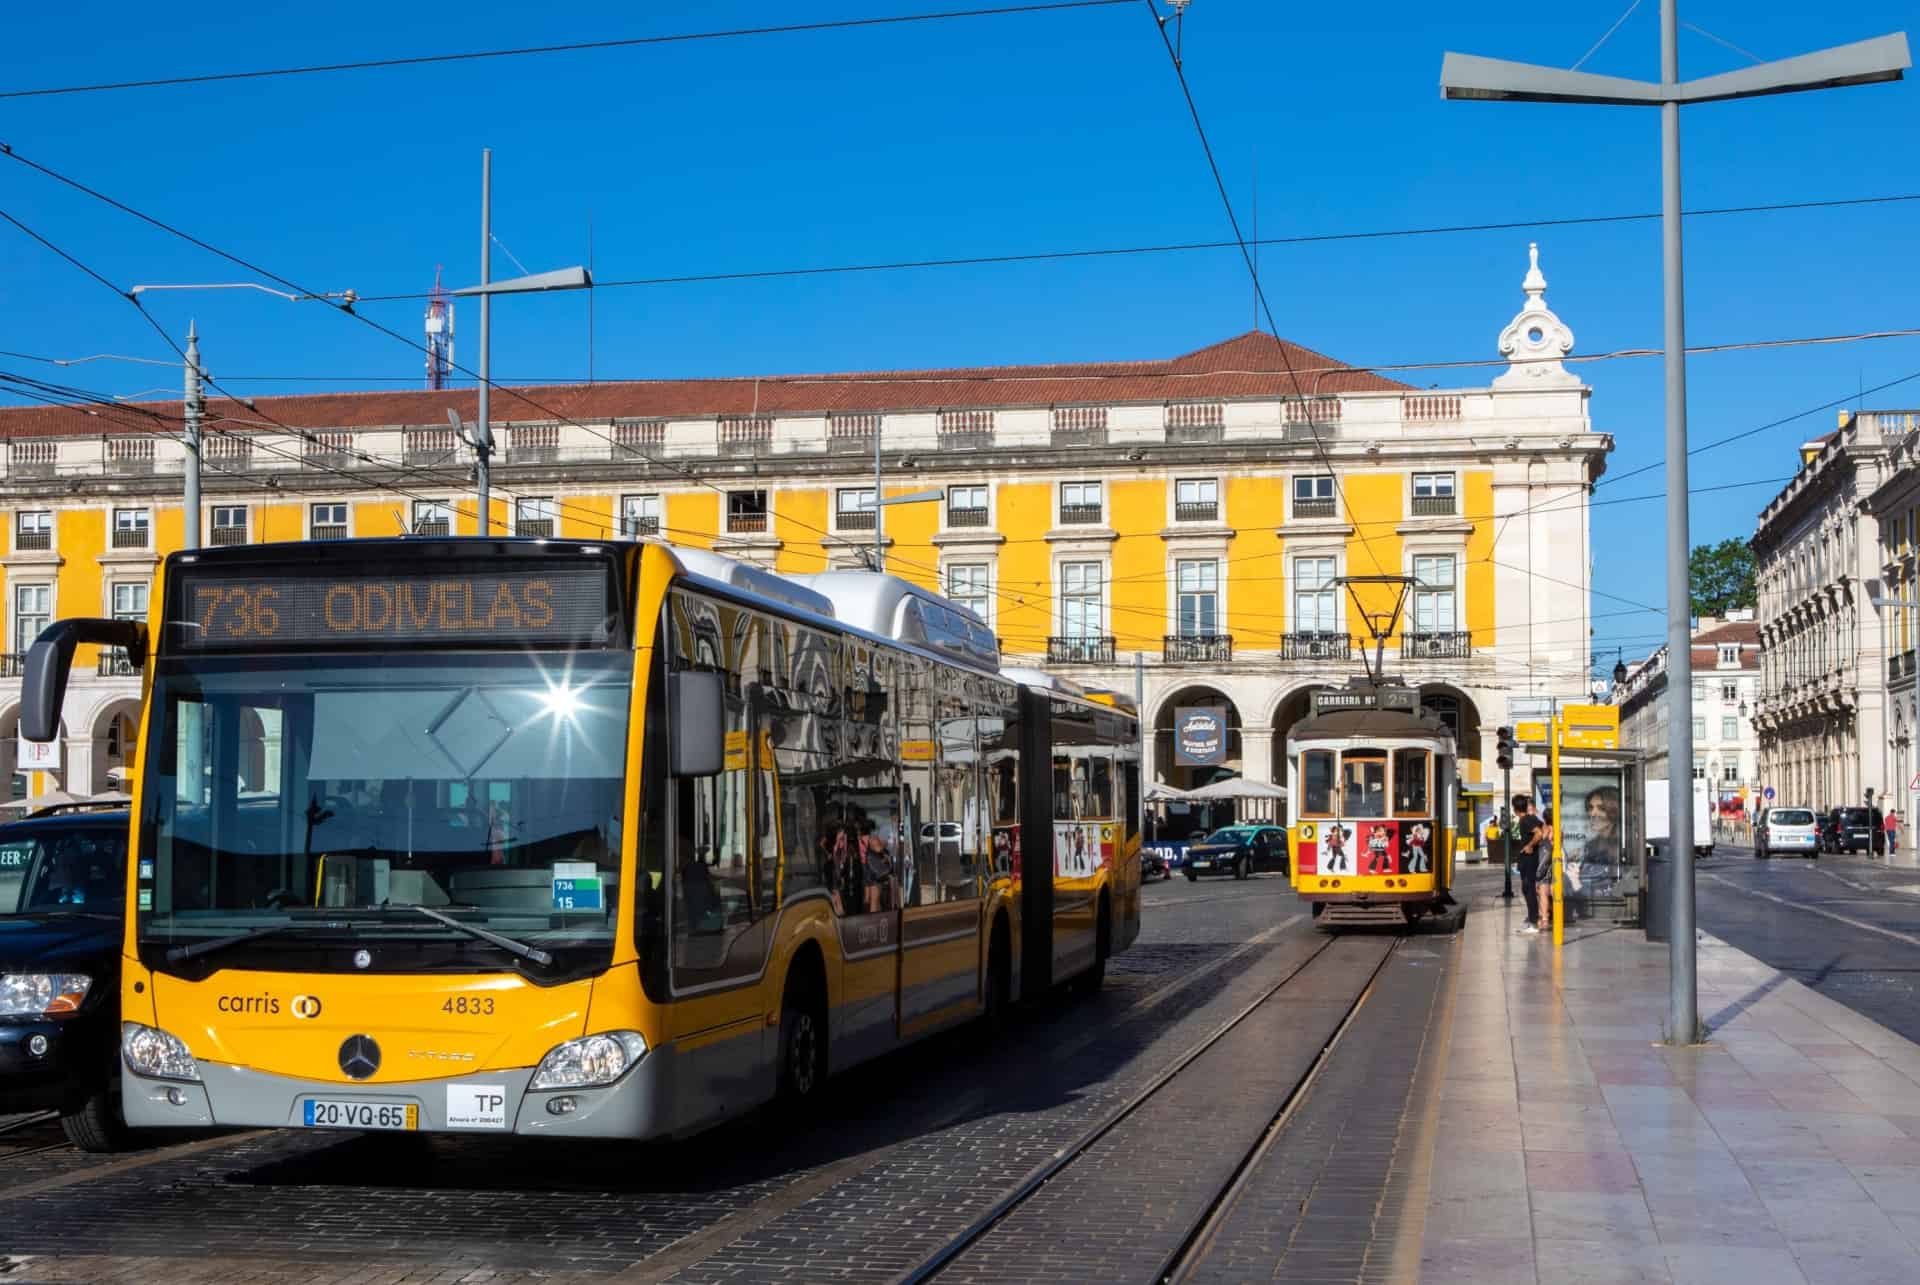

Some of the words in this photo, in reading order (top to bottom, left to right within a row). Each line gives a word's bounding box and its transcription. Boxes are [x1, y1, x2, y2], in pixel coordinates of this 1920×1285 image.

[195, 584, 281, 637] 736
[324, 580, 554, 632] ODIVELAS
[556, 881, 574, 890] 736
[558, 897, 574, 909] 15
[217, 992, 280, 1013] carris
[441, 997, 495, 1015] 4833
[475, 1094, 504, 1112] TP
